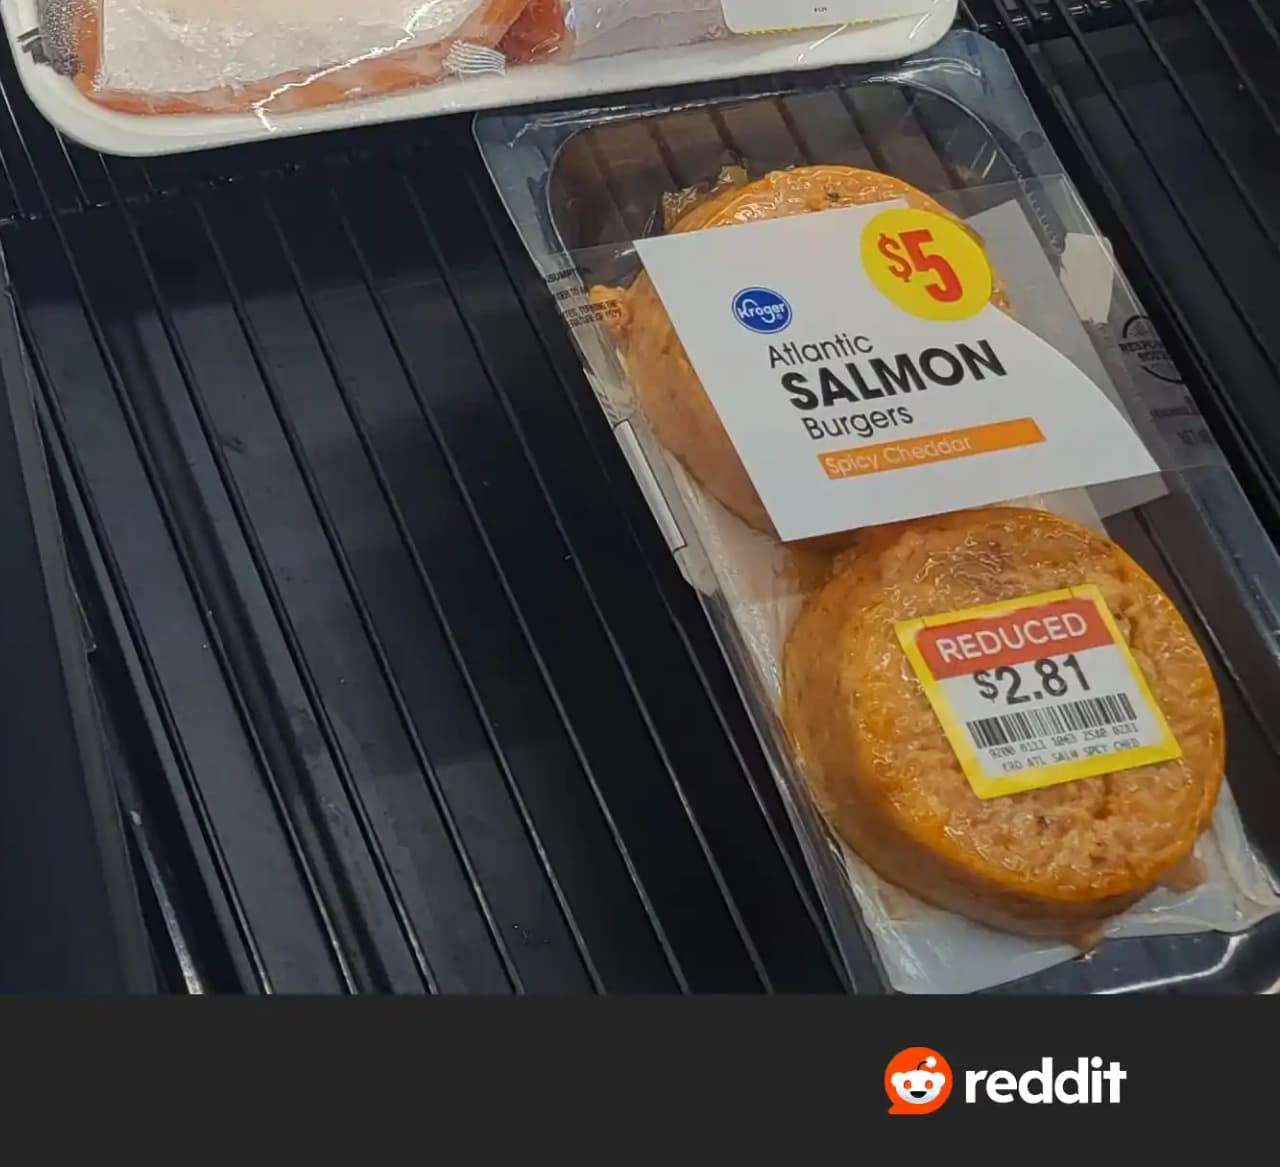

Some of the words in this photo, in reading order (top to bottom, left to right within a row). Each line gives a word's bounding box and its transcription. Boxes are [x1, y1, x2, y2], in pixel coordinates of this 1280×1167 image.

[877, 229, 963, 303] $5
[737, 298, 787, 325] Kroger
[769, 333, 874, 369] Atlantic
[781, 339, 1009, 411] SALMON
[801, 403, 914, 440] Burgers
[825, 451, 878, 478] Spicy
[882, 434, 972, 464] Cheddar
[935, 612, 1087, 663] REDUCED
[972, 654, 1090, 705] $2.81
